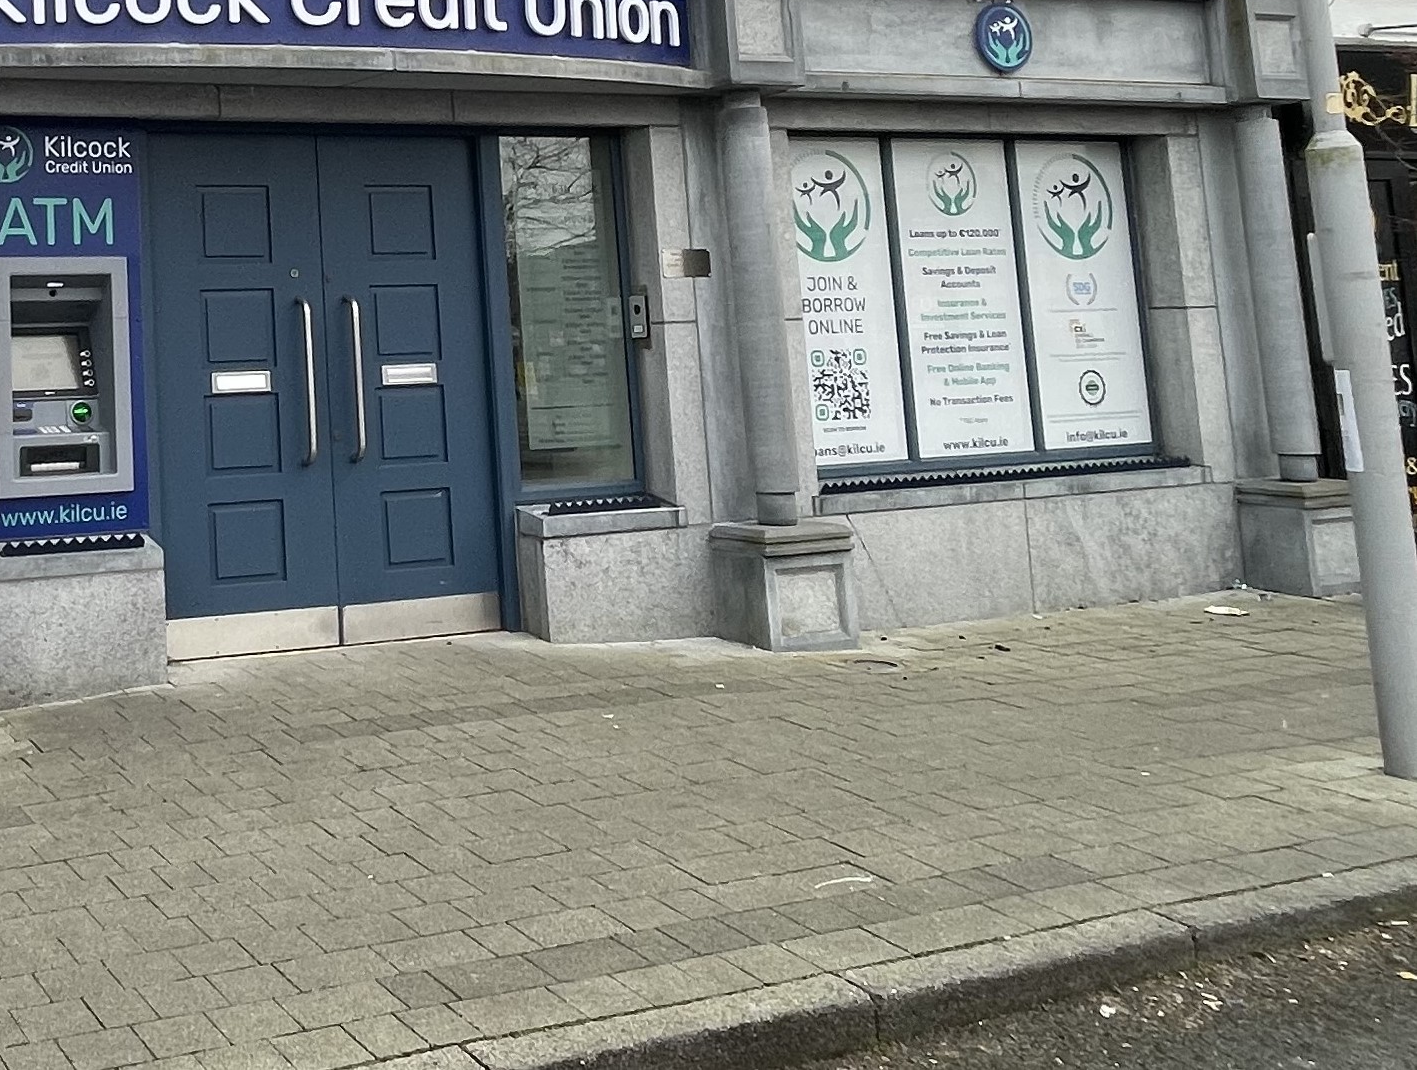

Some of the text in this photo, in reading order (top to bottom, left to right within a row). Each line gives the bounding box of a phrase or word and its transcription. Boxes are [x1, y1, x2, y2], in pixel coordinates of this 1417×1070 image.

[44, 136, 131, 158] Kilcock
[45, 160, 132, 173] Credit Union
[948, 229, 957, 237] to
[922, 266, 955, 277] Savings
[806, 275, 858, 292] JOIN &
[802, 296, 866, 313] BORROW
[808, 318, 864, 335] ONLINE
[924, 332, 942, 341] Free
[944, 331, 977, 341] Savings
[930, 394, 1013, 406] No Transaction Fees
[1066, 428, 1128, 442] info@kilcu.ie
[943, 435, 1009, 450] www.kilcu.ie
[1, 500, 127, 527] www.kilcu.ie
